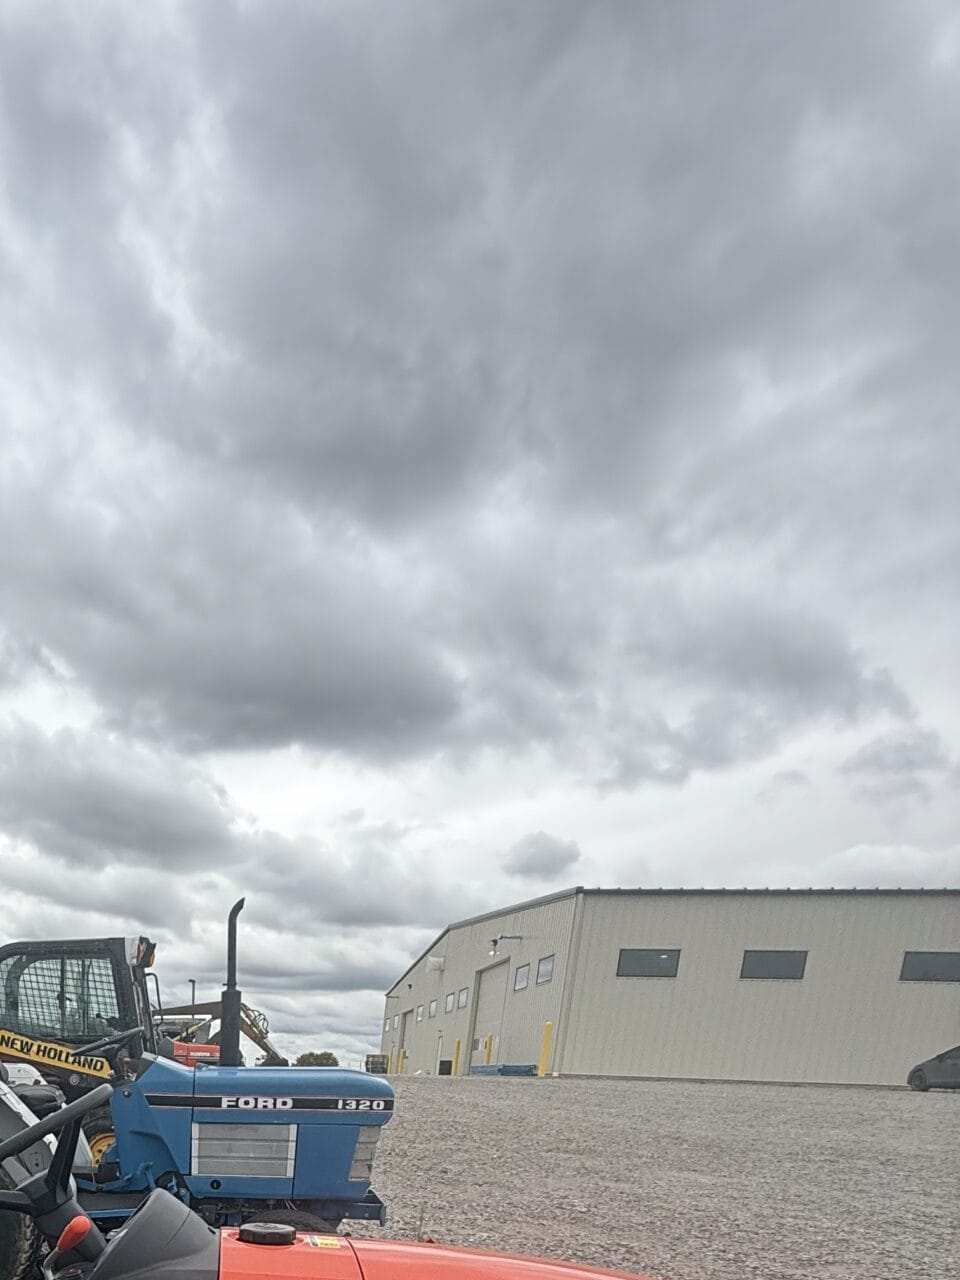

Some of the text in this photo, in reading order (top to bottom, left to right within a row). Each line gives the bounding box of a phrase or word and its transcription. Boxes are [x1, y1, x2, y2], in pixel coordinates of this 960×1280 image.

[0, 1034, 105, 1073] NEW HOLLAND
[220, 1096, 294, 1110] FORD
[337, 1099, 385, 1111] 1320
